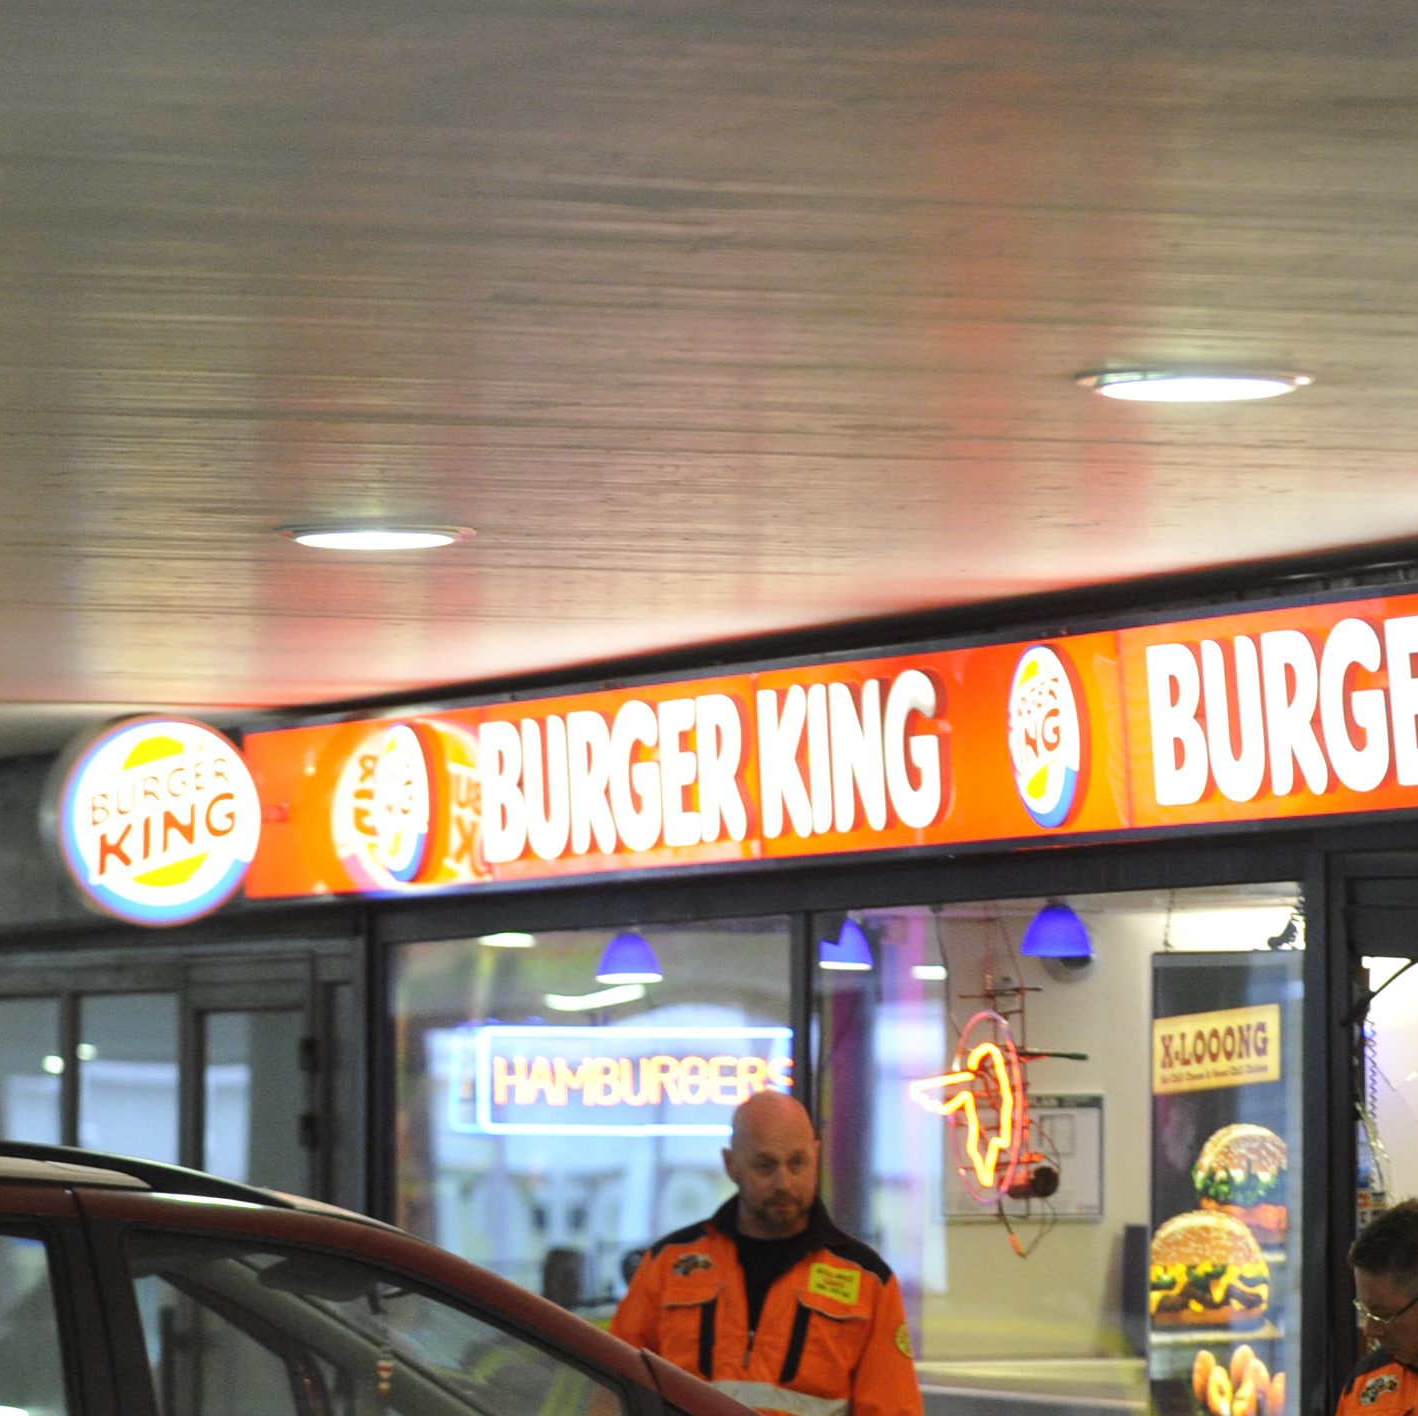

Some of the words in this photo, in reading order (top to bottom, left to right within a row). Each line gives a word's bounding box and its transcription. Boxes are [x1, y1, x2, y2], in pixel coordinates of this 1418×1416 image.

[91, 758, 230, 826] BURGER
[479, 694, 747, 863] BURGER
[757, 669, 941, 838] KING
[98, 792, 236, 876] KING
[1160, 1021, 1269, 1069] X-LOOONG
[492, 1055, 795, 1106] HAMBURGERS
